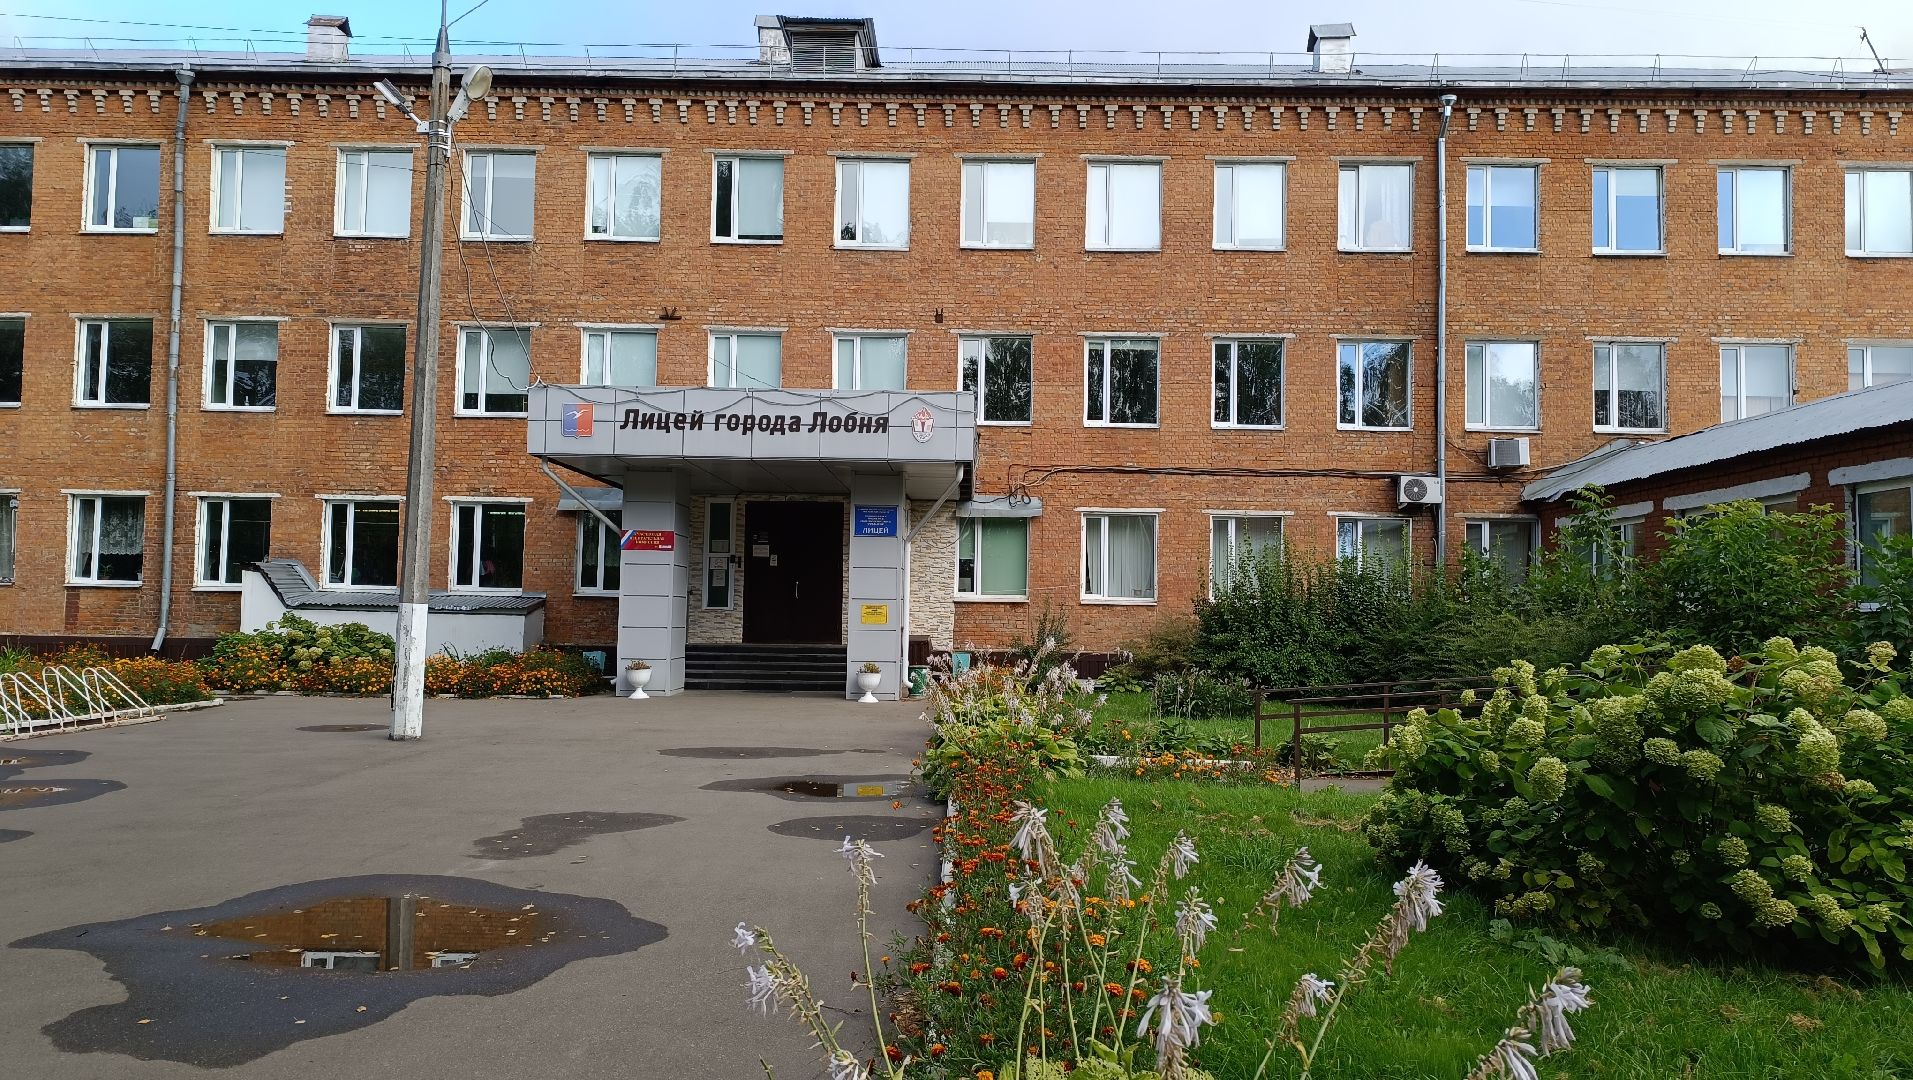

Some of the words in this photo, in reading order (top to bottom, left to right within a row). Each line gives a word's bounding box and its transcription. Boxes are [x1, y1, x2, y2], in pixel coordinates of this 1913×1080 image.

[620, 409, 704, 433] Лицей
[715, 414, 802, 436] города
[809, 411, 890, 433] Лобня
